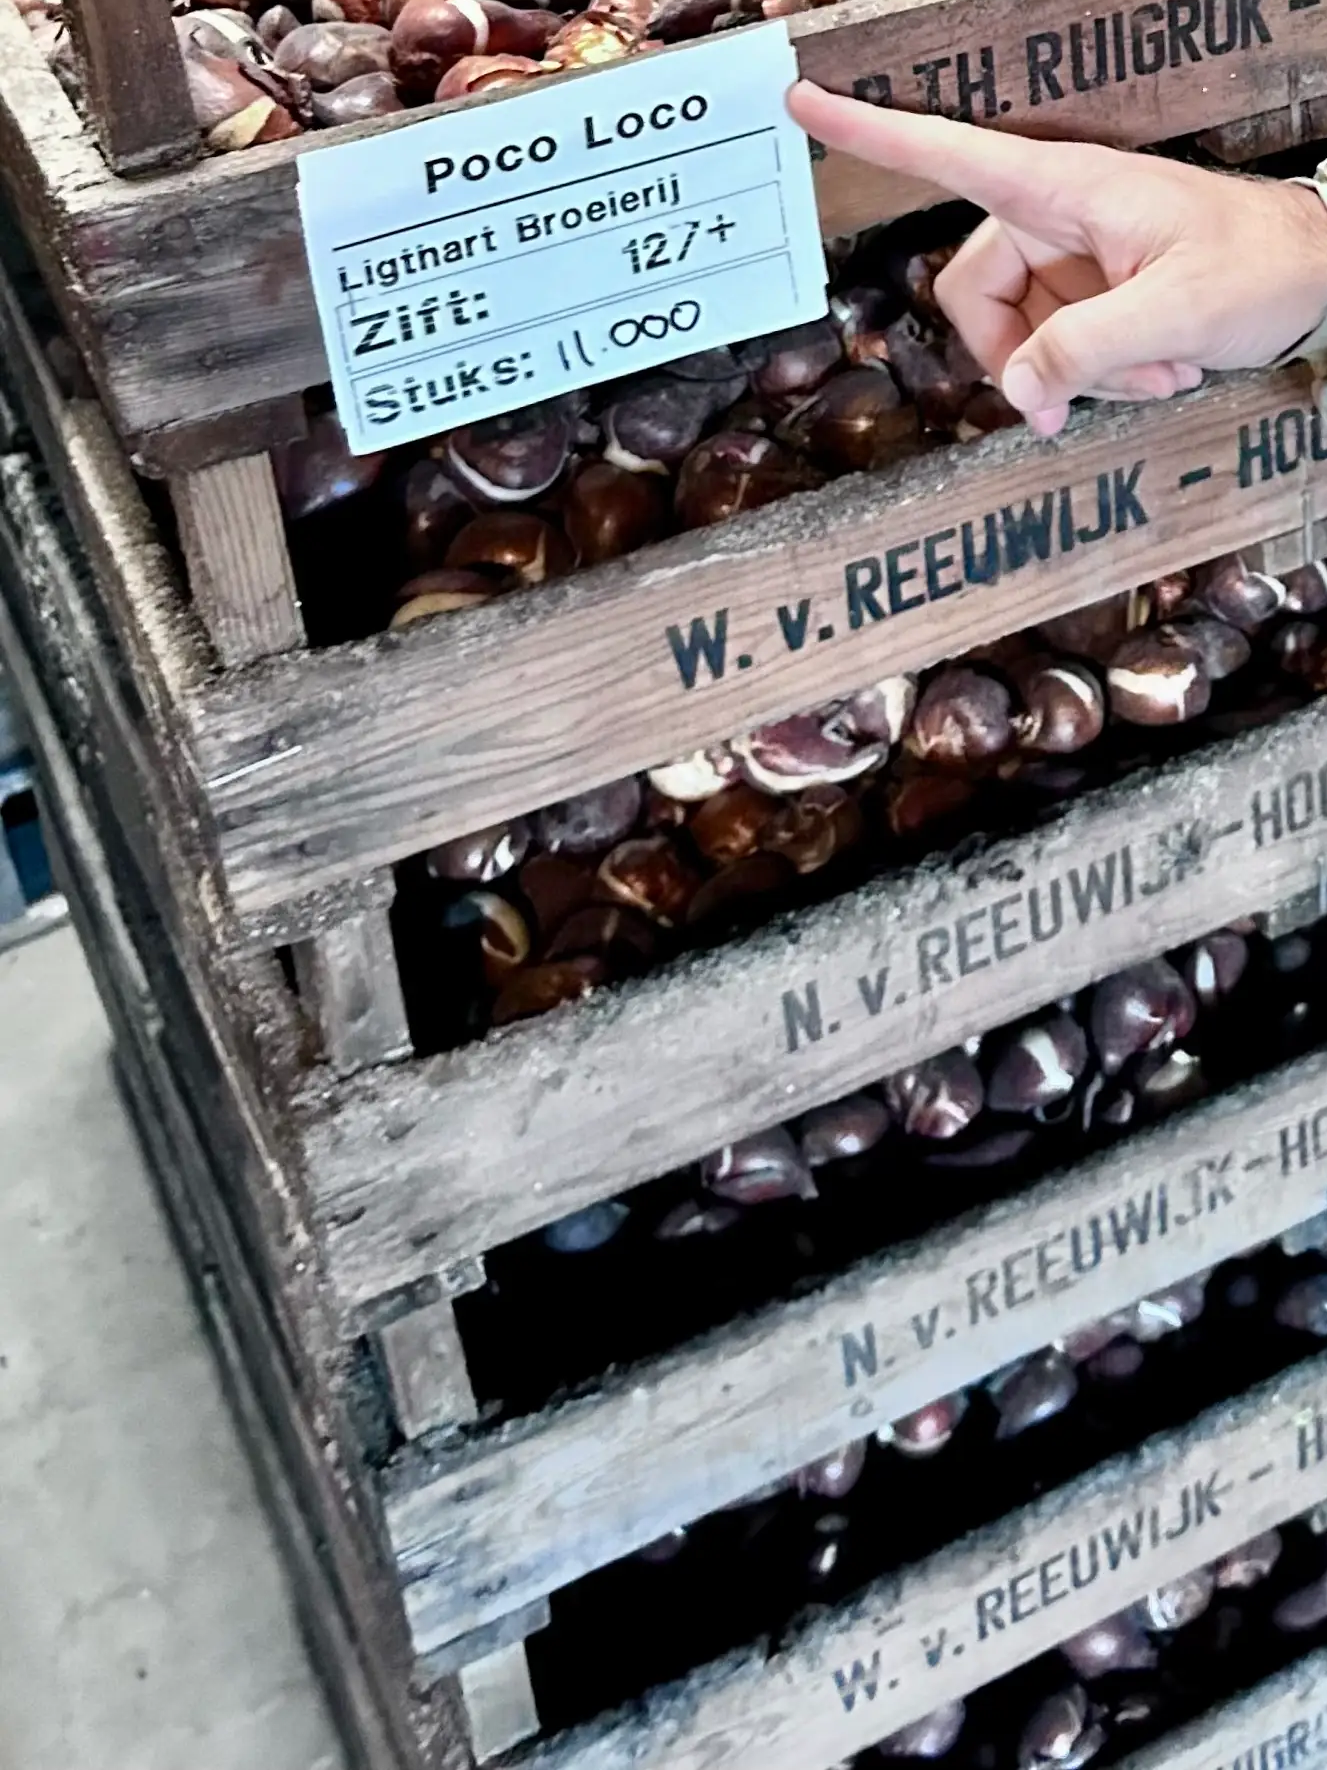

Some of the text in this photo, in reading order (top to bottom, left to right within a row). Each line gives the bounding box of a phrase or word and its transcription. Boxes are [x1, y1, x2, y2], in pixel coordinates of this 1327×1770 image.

[423, 93, 709, 194] Poco Loco
[338, 174, 681, 293] Ligthart Broeierij
[350, 213, 737, 357] Zift: 127+
[364, 350, 536, 425] Stuks:
[664, 606, 752, 690] W.
[844, 458, 1149, 631] REEUWIJK
[831, 1655, 900, 1714] W.
[972, 1474, 1226, 1643] REEUWIJK
